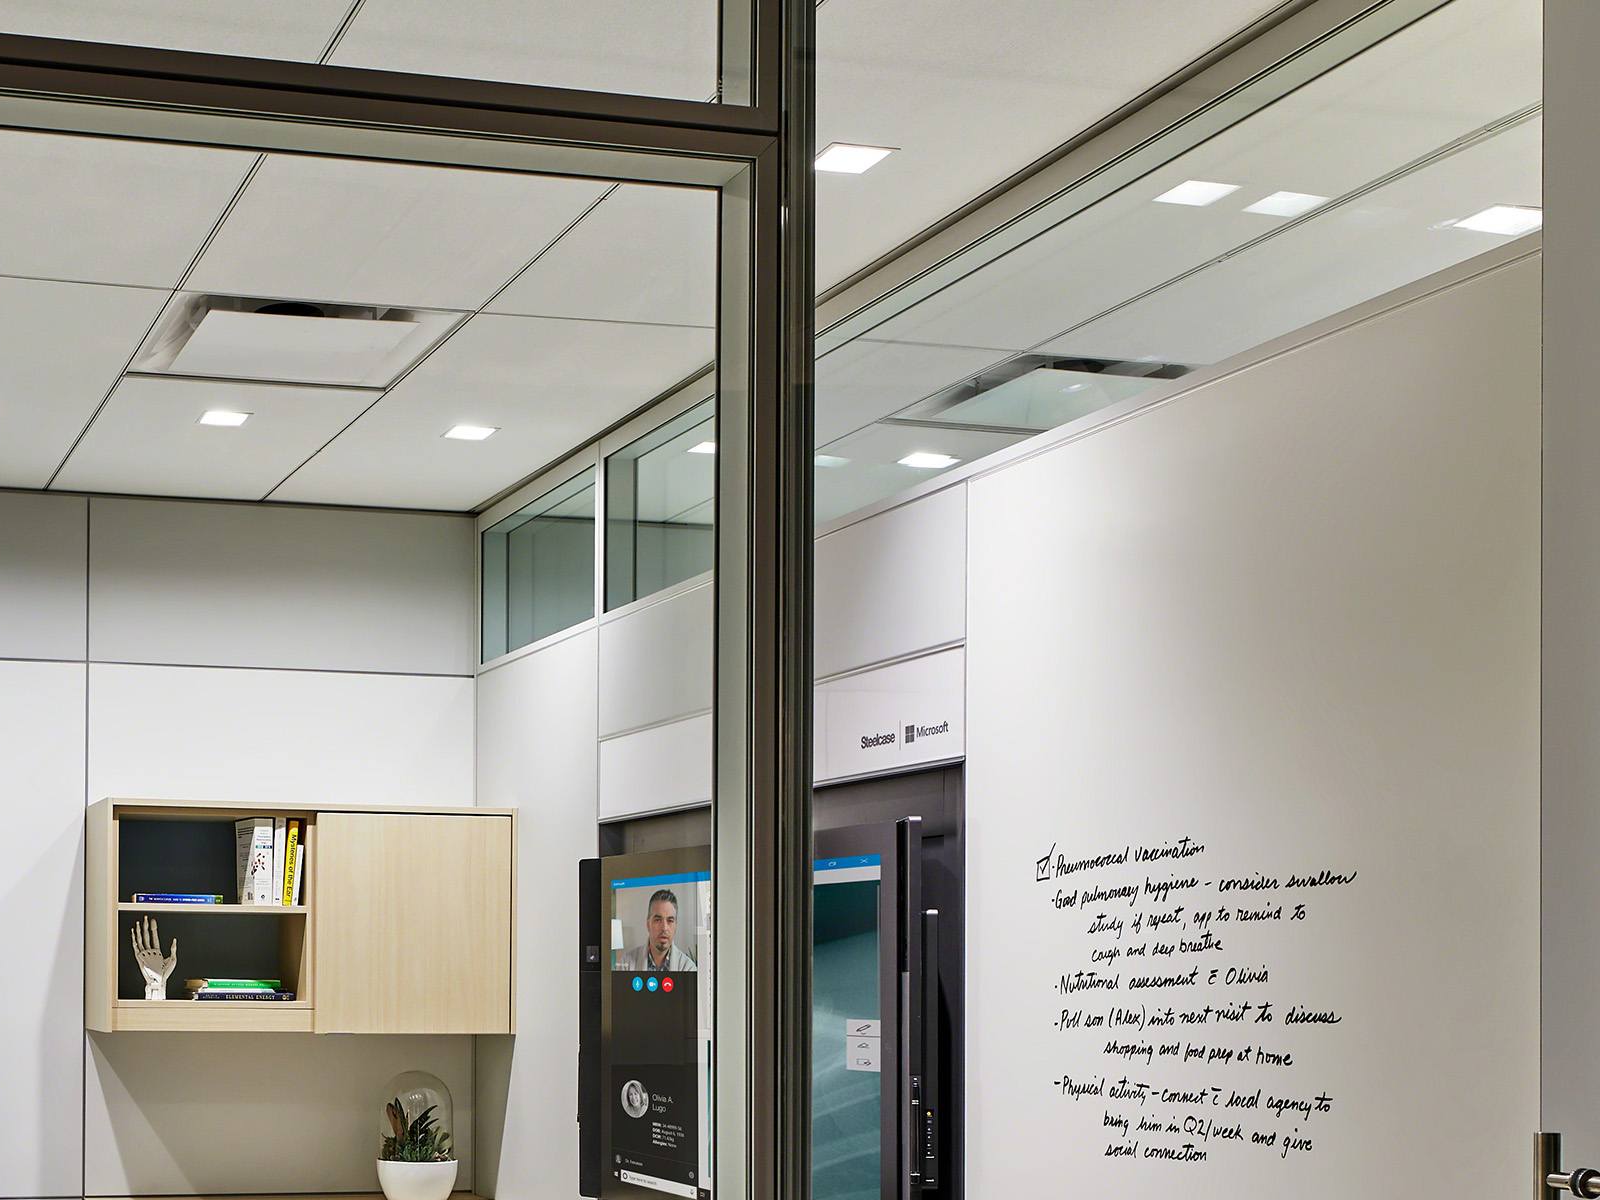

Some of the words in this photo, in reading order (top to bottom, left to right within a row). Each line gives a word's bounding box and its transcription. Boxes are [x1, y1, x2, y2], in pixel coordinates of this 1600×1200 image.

[861, 733, 895, 749] Steelcase
[916, 721, 949, 738] Microsoft
[289, 834, 297, 865] Mysteries
[1055, 845, 1130, 879] Pneumococcal
[1134, 835, 1205, 863] vaccination
[1079, 884, 1140, 911] pulmonary
[1143, 873, 1200, 903] hygiene
[1218, 871, 1281, 893] consider
[1284, 869, 1358, 889] swallow
[1086, 912, 1124, 940] study
[1130, 911, 1143, 935] if
[1193, 911, 1213, 932] app
[1215, 905, 1231, 922] to
[1235, 901, 1283, 922] remind
[1289, 903, 1306, 921] to
[1091, 946, 1121, 967] cough
[1126, 942, 1147, 958] and
[1151, 941, 1176, 958] deep
[1178, 928, 1224, 954] breathe
[1060, 969, 1120, 996] Nutritional
[1128, 965, 1200, 991] assessment
[1225, 964, 1269, 986] Olivia
[1083, 1013, 1104, 1028] son
[1108, 1004, 1146, 1032] (Alex)
[1147, 1007, 1176, 1027] into
[1178, 1004, 1214, 1025] next
[1214, 1000, 1253, 1023] visit
[1254, 1001, 1273, 1024] to
[1284, 1004, 1343, 1026] discuss
[1102, 1039, 1154, 1066] shopping
[1158, 1041, 1181, 1057] and
[1183, 1042, 1206, 1063] food
[1207, 1047, 1234, 1065] prep
[1236, 1045, 1253, 1062] at
[1255, 1045, 1294, 1067] home
[652, 1093, 667, 1103] Olivia
[652, 1104, 667, 1113] Lugo
[1108, 1075, 1151, 1107] activity
[1224, 1088, 1262, 1109] local
[1266, 1095, 1313, 1122] agency
[1314, 1091, 1334, 1113] to
[1103, 1109, 1130, 1138] bring
[1135, 1113, 1163, 1132] him
[1164, 1115, 1181, 1134] in
[1251, 1131, 1277, 1147] and
[1280, 1127, 1313, 1159] give
[1104, 1139, 1139, 1159] social
[1143, 1142, 1207, 1163] connection
